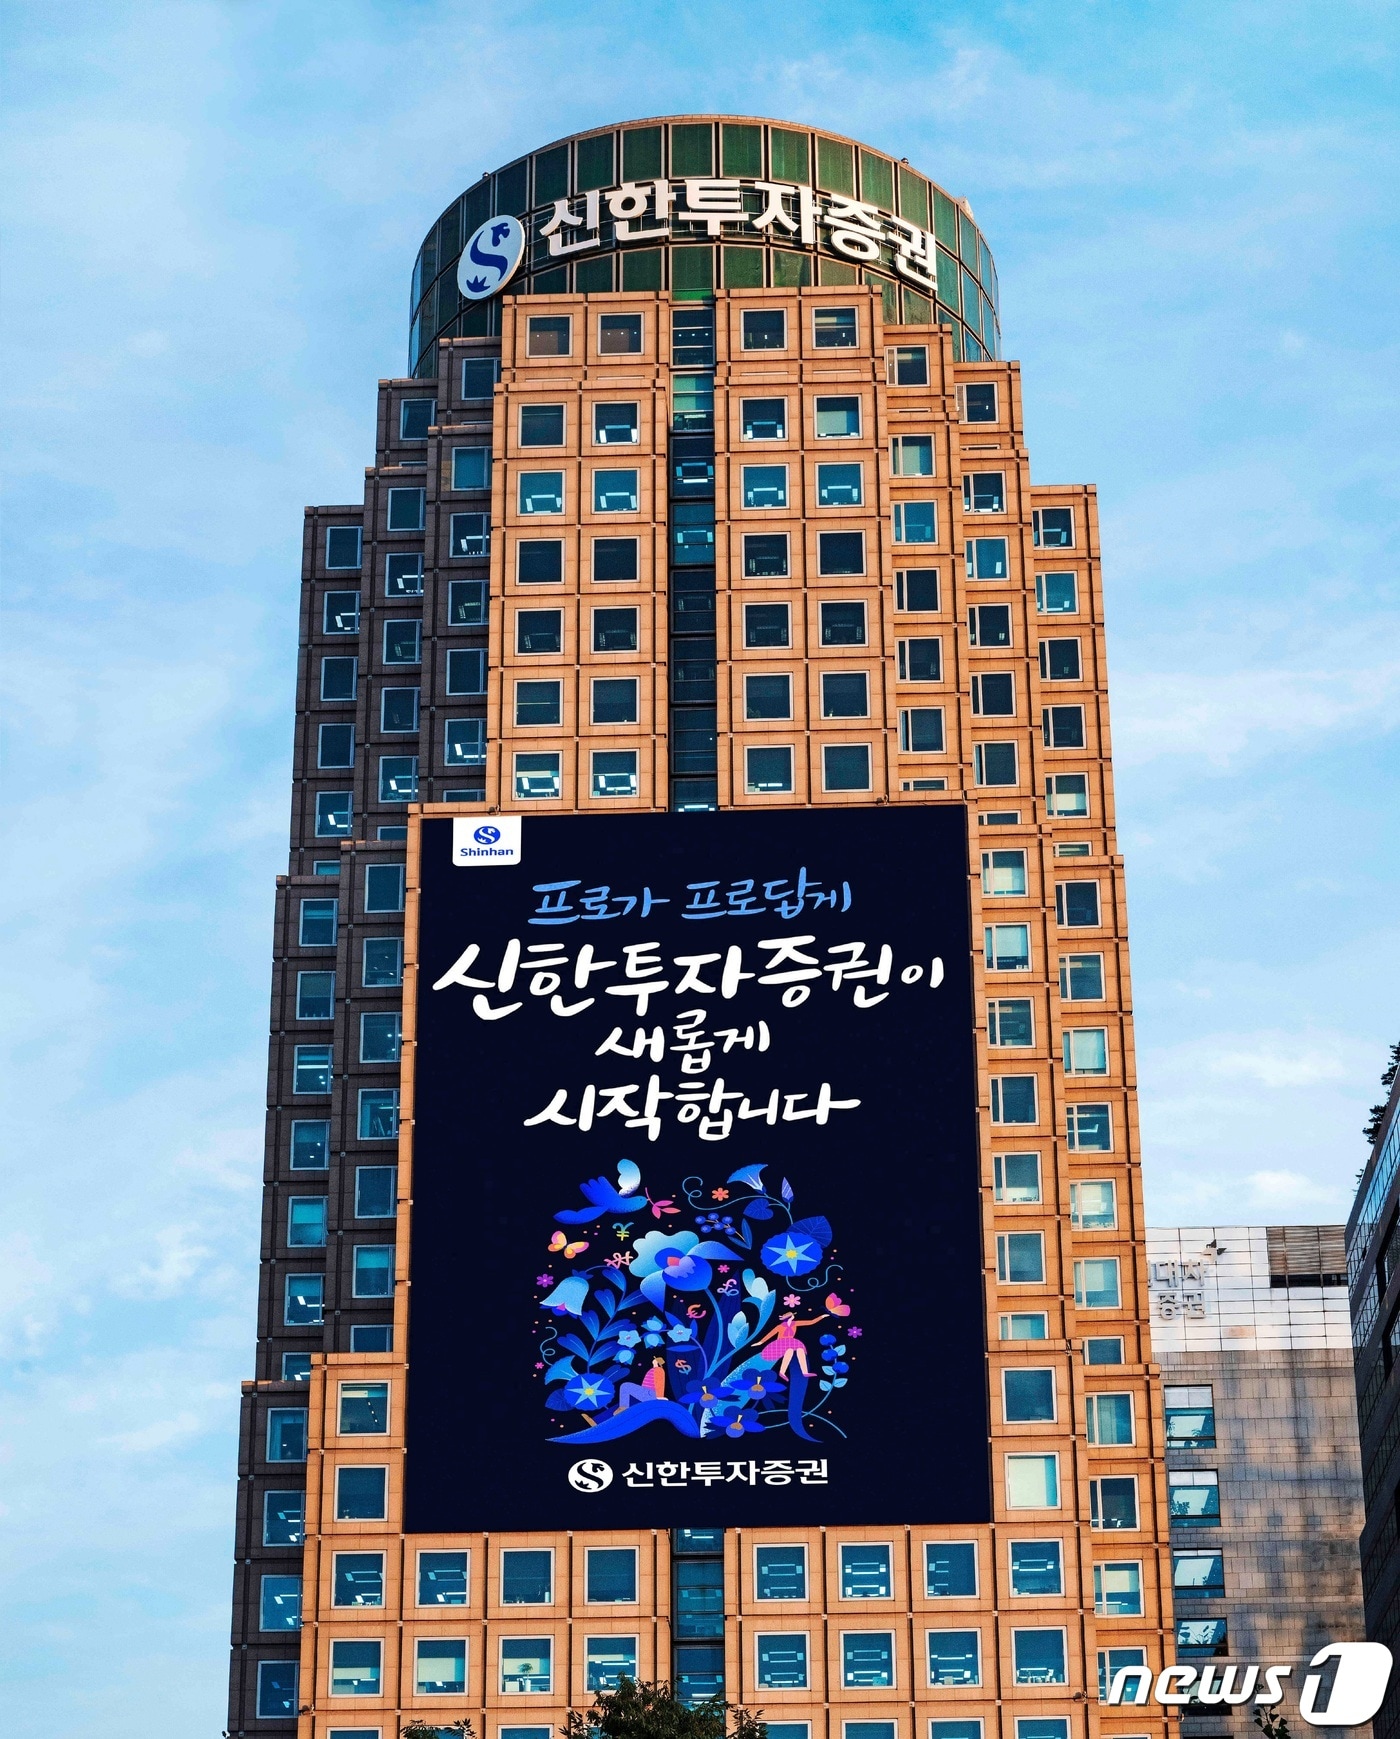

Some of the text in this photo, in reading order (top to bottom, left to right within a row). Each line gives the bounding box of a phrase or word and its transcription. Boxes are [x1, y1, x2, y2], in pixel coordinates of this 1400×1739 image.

[539, 178, 938, 291] 신한투자증권
[460, 847, 514, 857] Shinhan
[527, 866, 852, 926] 프로가 프로답게
[432, 935, 945, 1020] 신한투자증권이
[594, 1008, 771, 1075] 새롭게
[523, 1074, 862, 1142] 시작합니다
[621, 1458, 829, 1488] 신한투자증권
